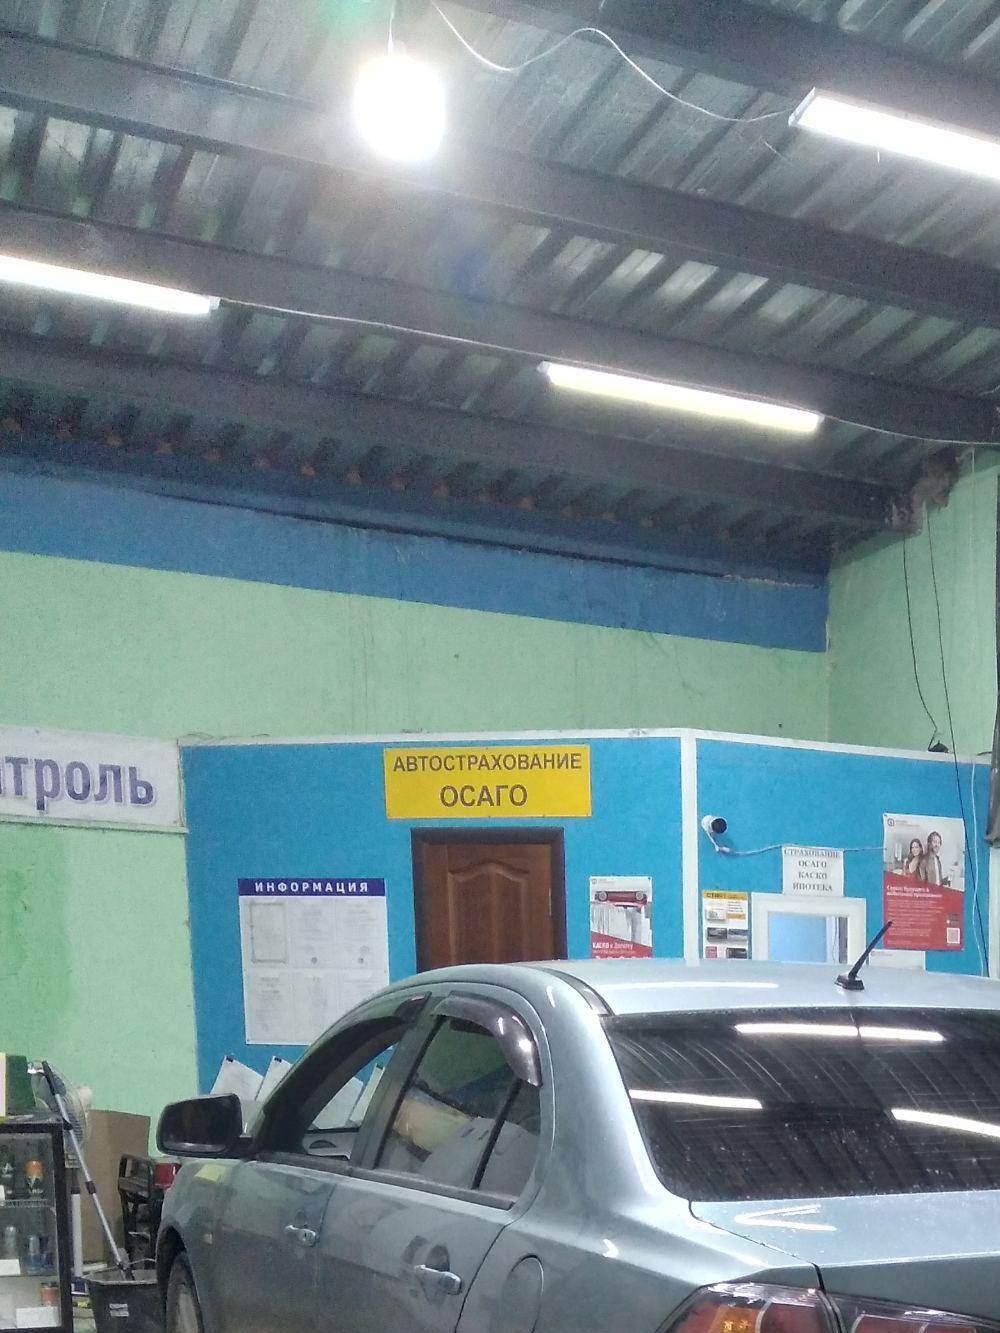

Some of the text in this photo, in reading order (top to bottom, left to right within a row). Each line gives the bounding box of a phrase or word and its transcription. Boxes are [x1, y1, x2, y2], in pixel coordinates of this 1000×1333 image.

[393, 752, 582, 772] АВТОСТРАХОВАНИЕ
[0, 756, 154, 811] троль
[440, 784, 528, 808] ОСАГО
[255, 882, 369, 893] ИНФОРМАЦИЯ
